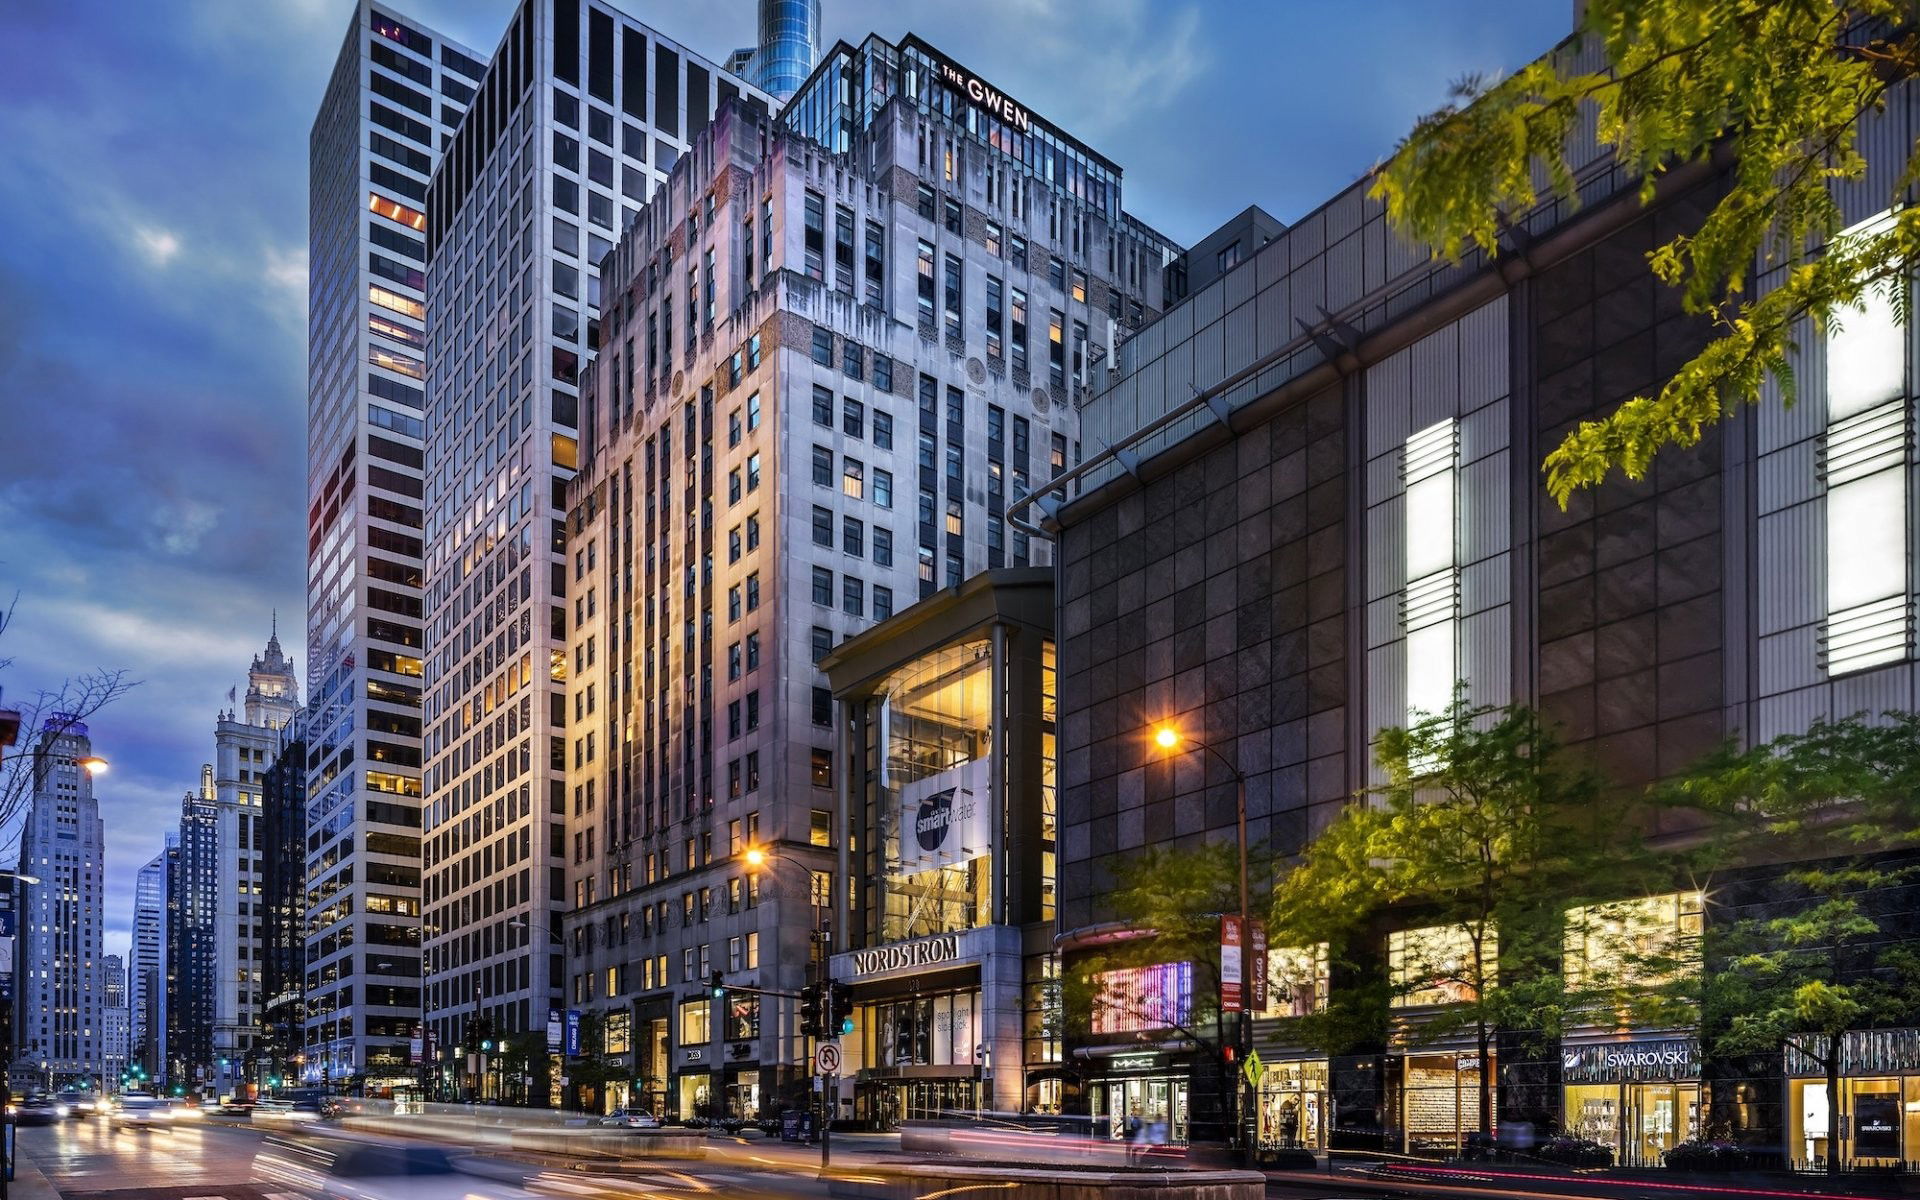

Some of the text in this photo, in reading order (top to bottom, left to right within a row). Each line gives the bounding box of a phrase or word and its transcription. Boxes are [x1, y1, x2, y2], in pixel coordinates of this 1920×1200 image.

[942, 64, 1028, 131] THE GWEN
[854, 935, 960, 976] NORDSTROM
[937, 1007, 969, 1021] spoight
[937, 1020, 970, 1032] sideick.
[1607, 1050, 1689, 1067] SWAROVSKI
